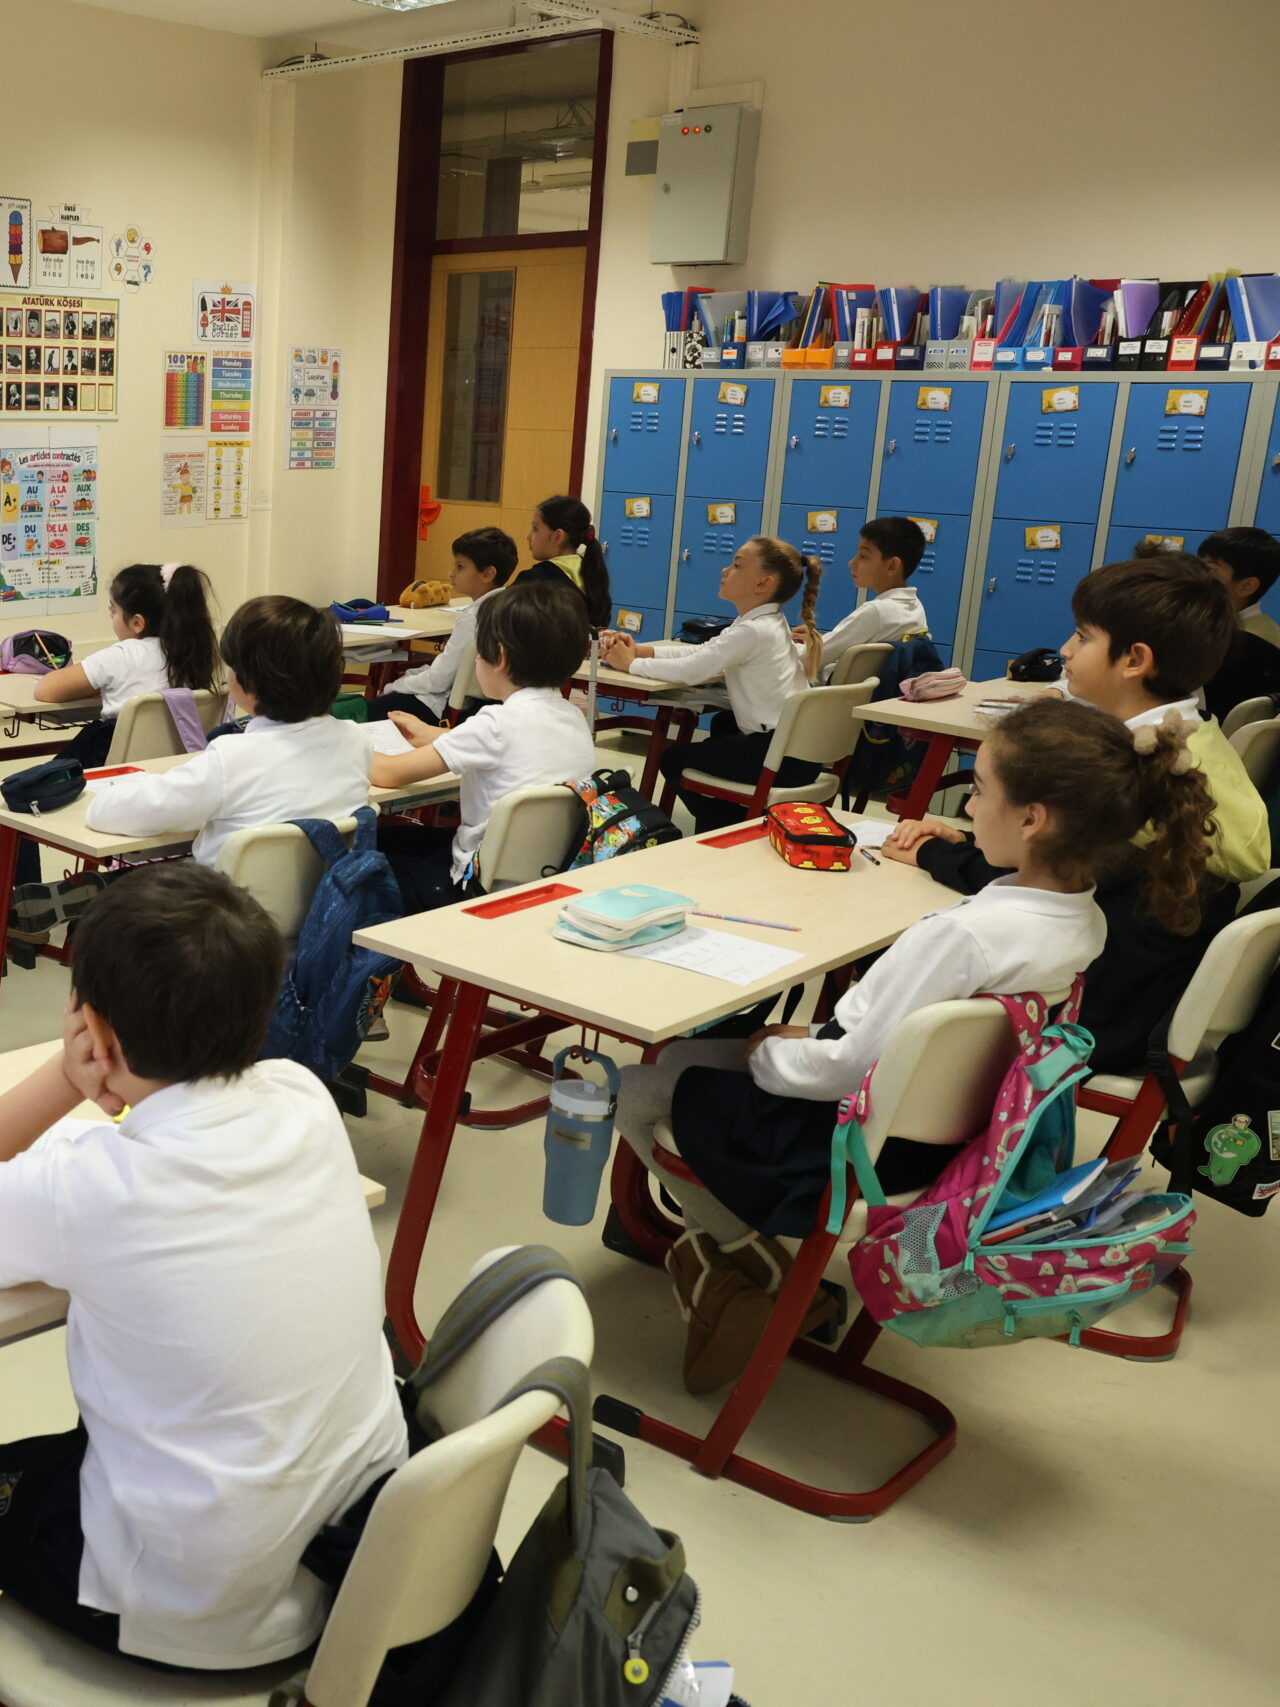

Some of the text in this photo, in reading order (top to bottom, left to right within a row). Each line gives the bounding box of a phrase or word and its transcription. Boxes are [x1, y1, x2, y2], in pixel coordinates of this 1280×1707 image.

[22, 296, 83, 308] ATATÜRK KÖŞESİ
[212, 323, 238, 332] English
[168, 354, 185, 364] 100
[19, 451, 81, 465] Les articles contractés
[27, 486, 38, 494] AU
[51, 484, 56, 493] À
[76, 484, 91, 492] AUX
[25, 525, 36, 533] DU
[47, 524, 68, 532] DE LA
[76, 523, 89, 531] DES
